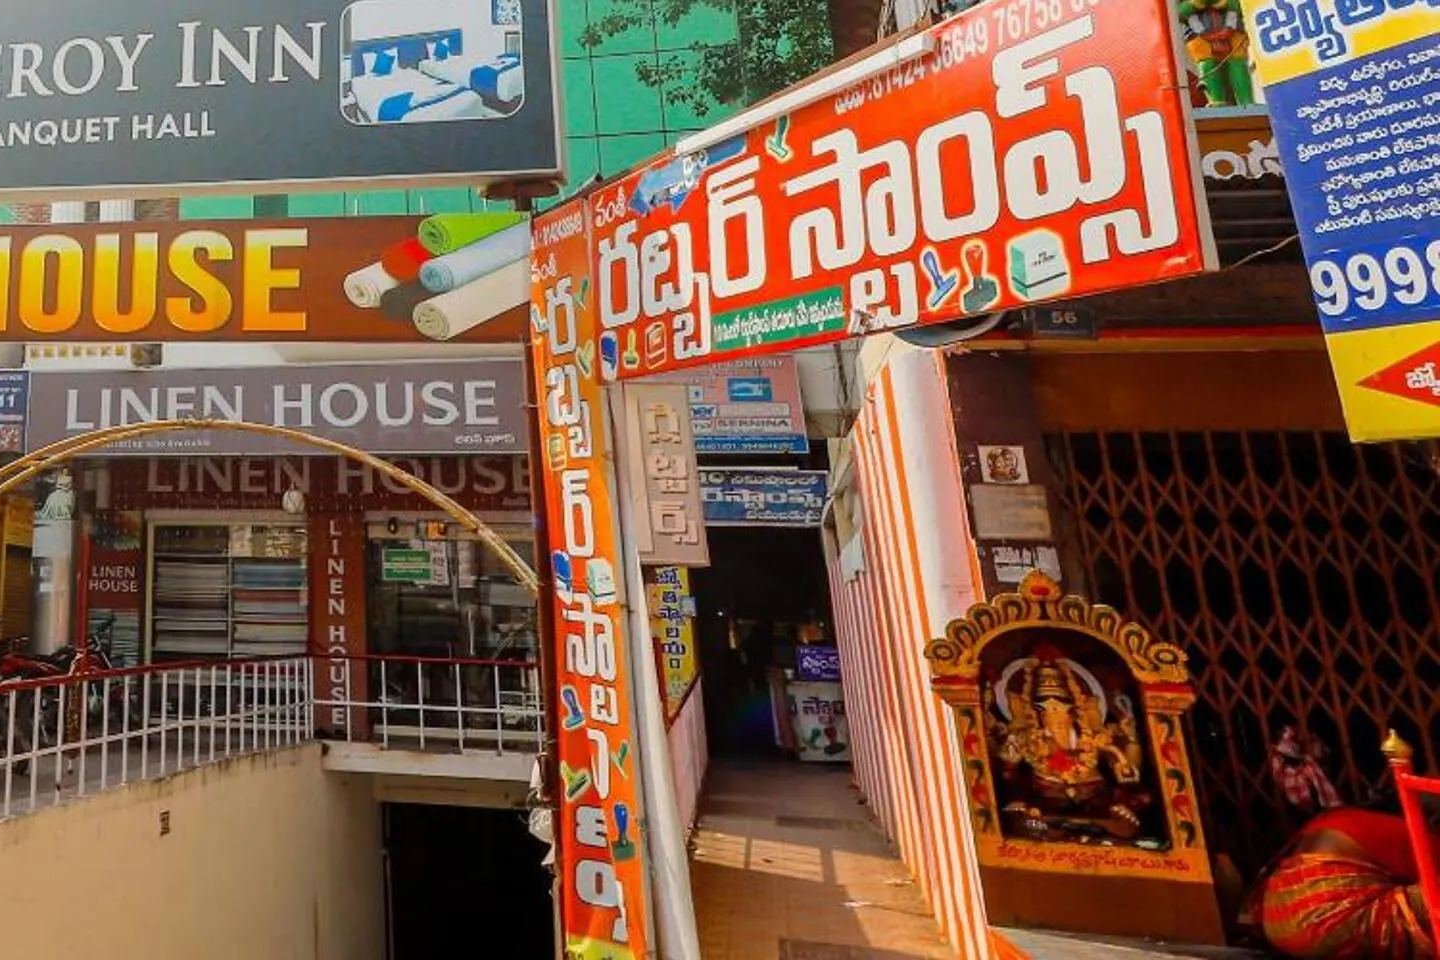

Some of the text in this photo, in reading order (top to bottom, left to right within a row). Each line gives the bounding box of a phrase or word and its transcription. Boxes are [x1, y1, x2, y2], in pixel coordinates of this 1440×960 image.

[176, 20, 327, 88] INN
[131, 109, 217, 141] HALL
[66, 379, 500, 431] LINEN HOUSE
[148, 457, 310, 493] LINEN
[89, 580, 139, 594] HOUSE
[91, 565, 136, 579] LINEN
[327, 519, 348, 727] LINEN HOUSE
